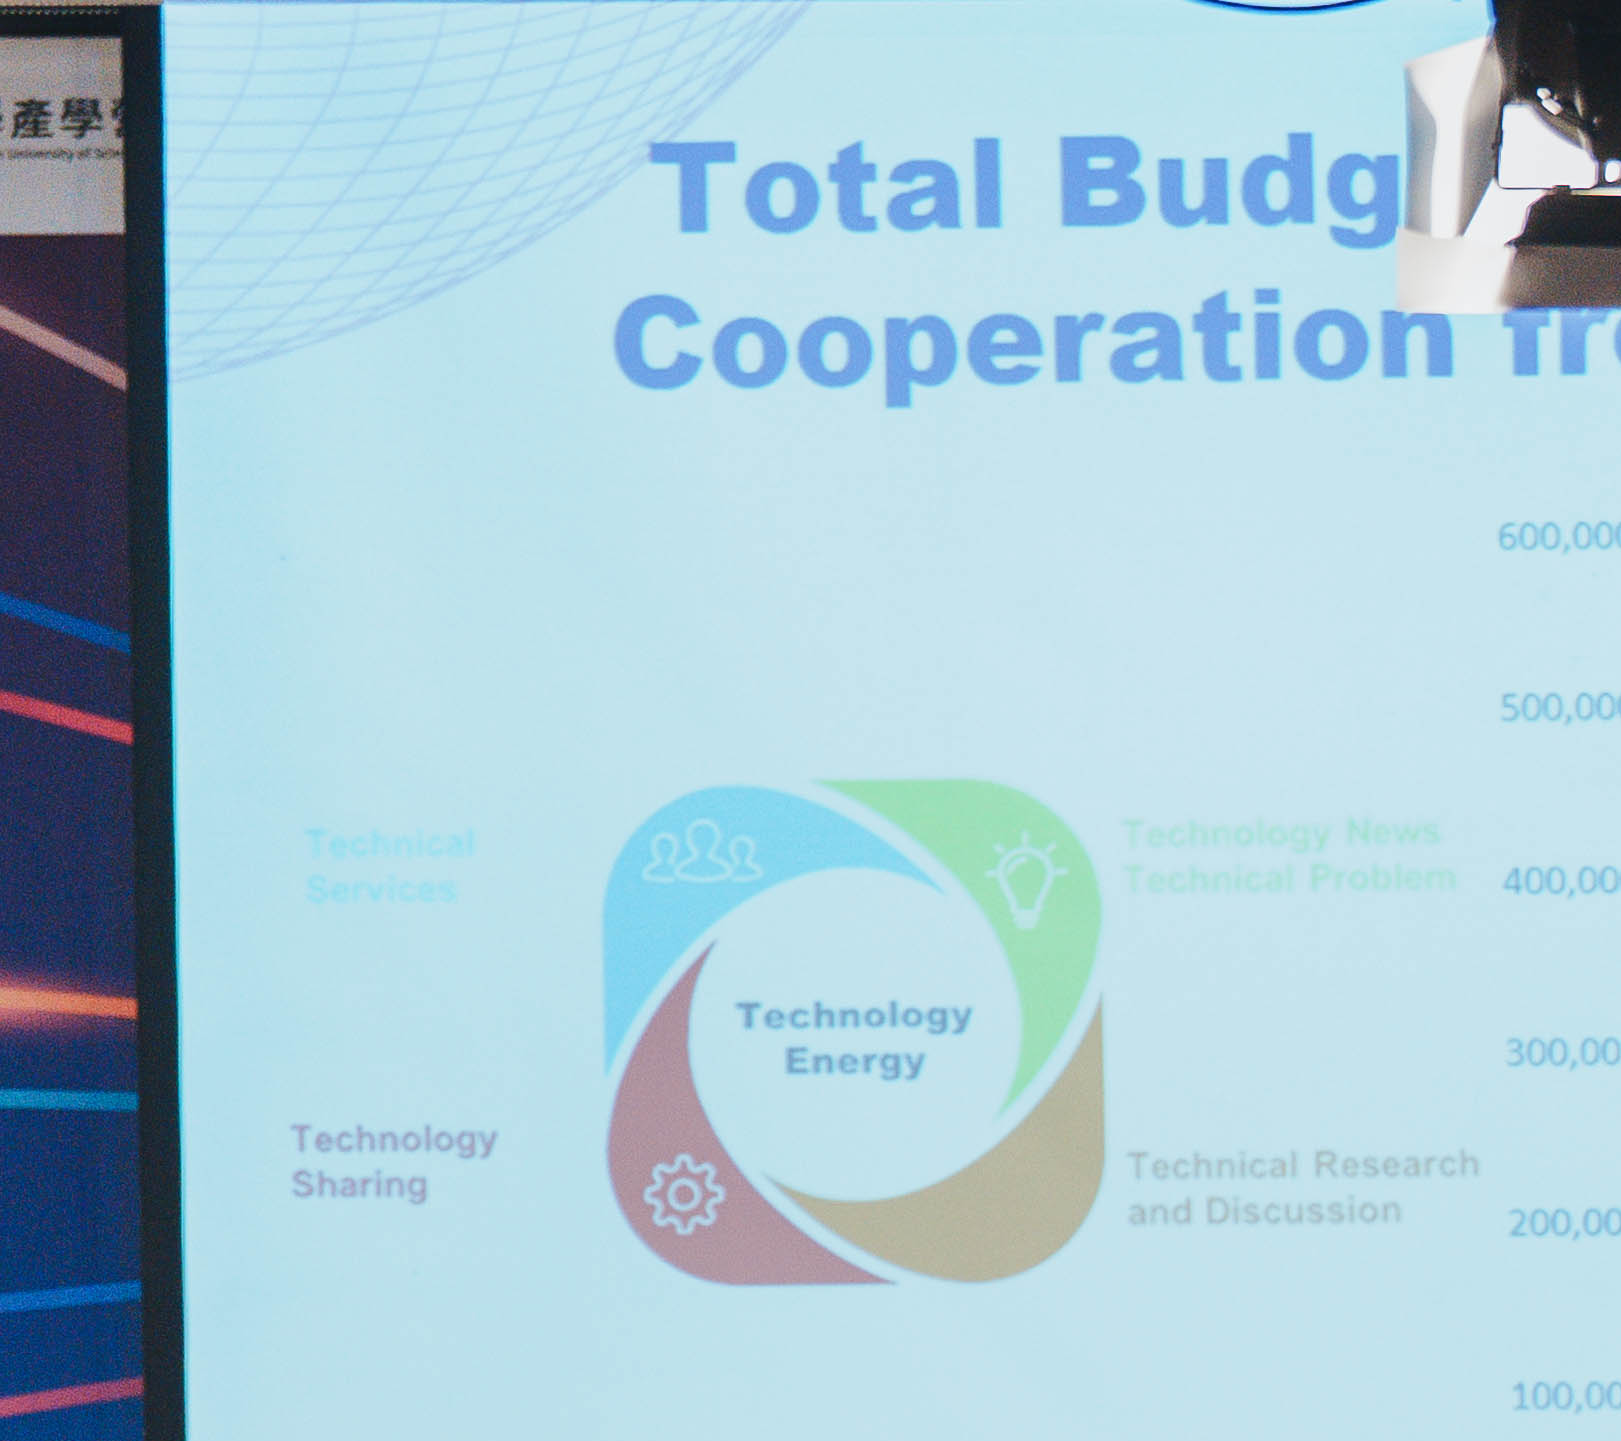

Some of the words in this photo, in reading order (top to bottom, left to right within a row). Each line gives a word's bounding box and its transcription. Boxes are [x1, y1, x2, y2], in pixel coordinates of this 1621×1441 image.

[0, 97, 123, 139] 產學
[647, 137, 1002, 234] Total
[1060, 132, 1399, 249] Budg
[614, 288, 1453, 408] Cooperation
[304, 826, 475, 860] Technical
[1122, 818, 1331, 854] Technology
[1347, 817, 1441, 844] News
[306, 874, 456, 905] Services
[1123, 864, 1294, 893] Technical
[1310, 863, 1457, 891] Problem
[736, 1001, 972, 1035] Technology
[786, 1047, 925, 1081] Energy
[291, 1124, 498, 1159] Technology
[1127, 1151, 1297, 1180] Technical
[1315, 1149, 1479, 1178] Research
[292, 1169, 427, 1205] Sharing
[1129, 1197, 1192, 1225] and
[1206, 1195, 1401, 1225] Discussion
